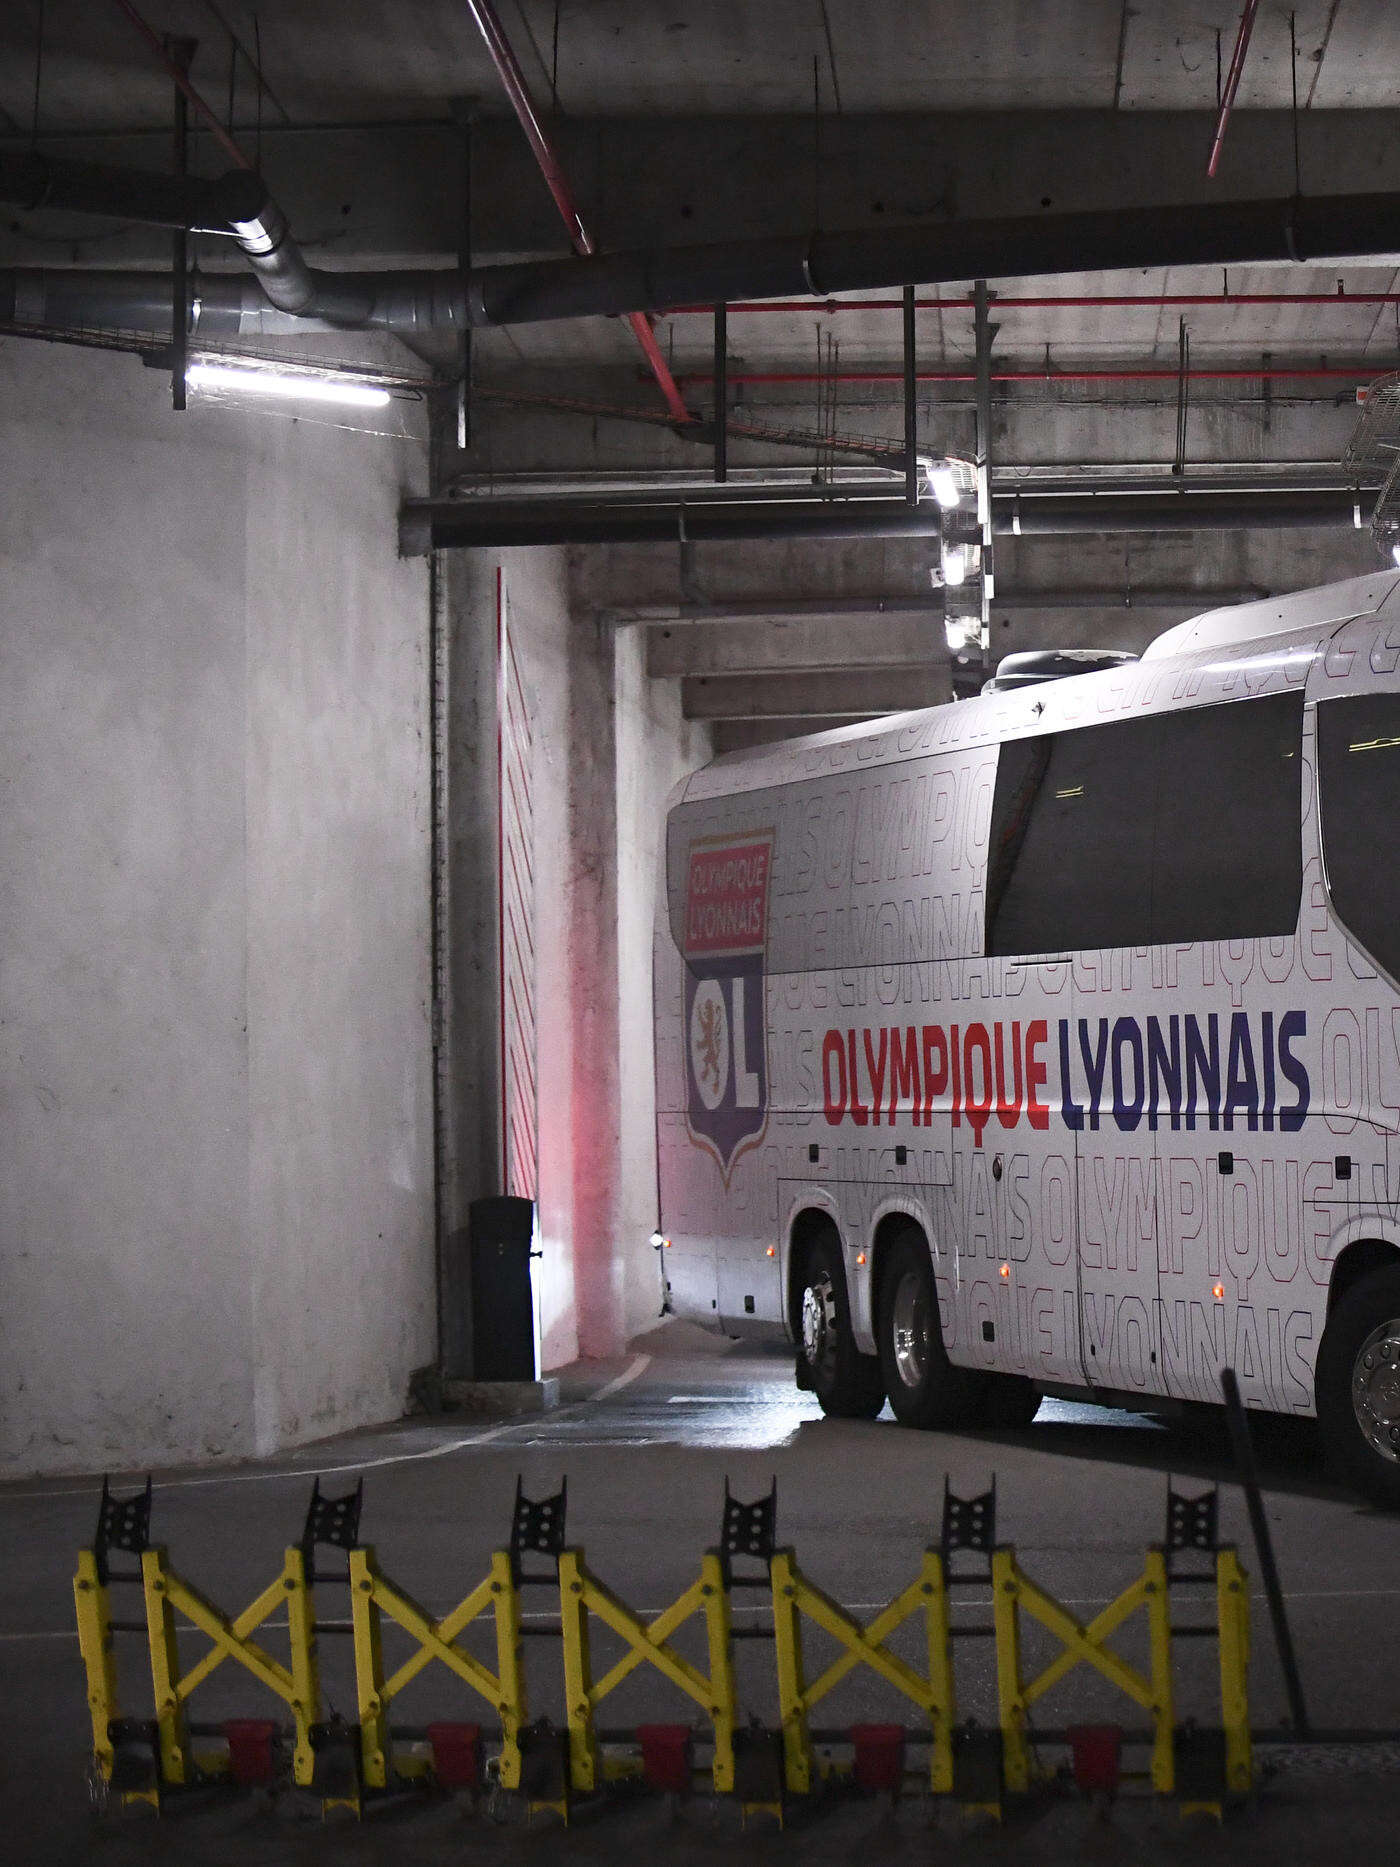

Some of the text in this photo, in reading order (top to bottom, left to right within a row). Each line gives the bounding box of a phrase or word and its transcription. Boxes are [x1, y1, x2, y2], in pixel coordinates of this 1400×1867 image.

[690, 977, 760, 1111] OL
[822, 1019, 1050, 1148] OLYMPIQUE
[1059, 1010, 1311, 1132] LYONNAIS
